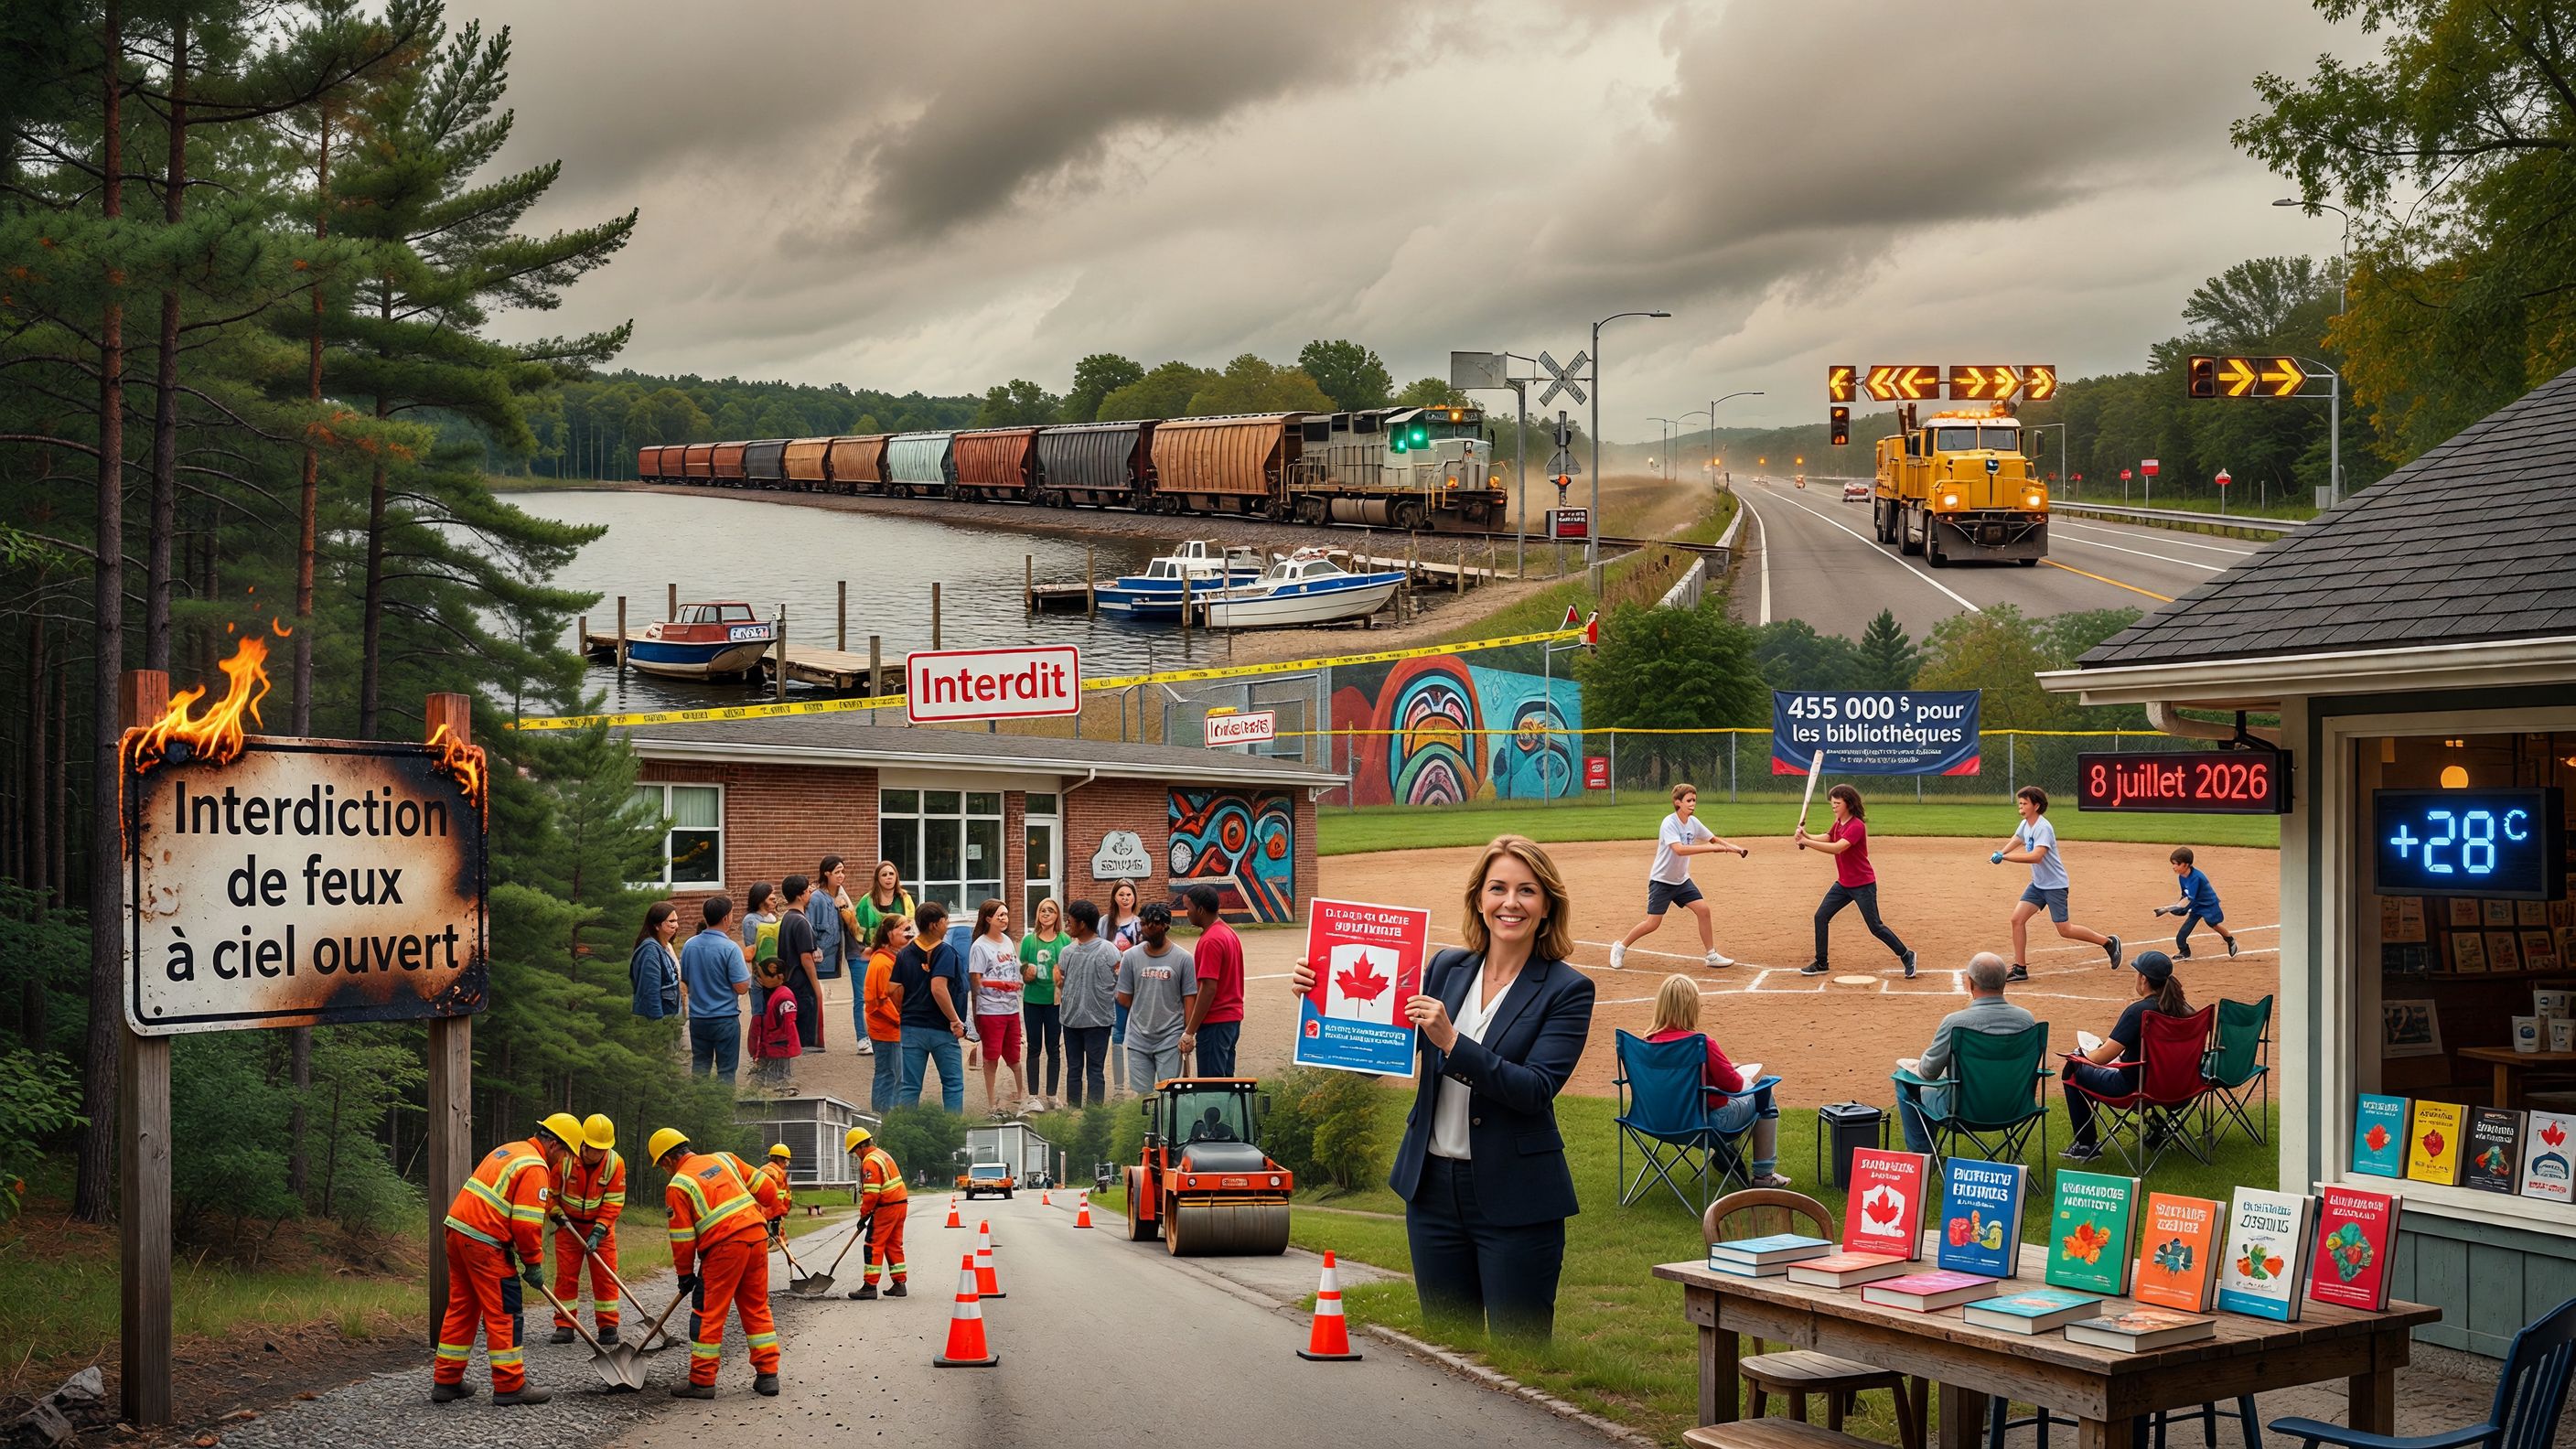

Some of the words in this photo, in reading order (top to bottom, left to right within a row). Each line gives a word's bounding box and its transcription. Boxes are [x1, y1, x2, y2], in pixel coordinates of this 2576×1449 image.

[922, 661, 1067, 704] Interdit
[1787, 696, 1838, 719] 455
[1844, 696, 1894, 719] 000
[1916, 704, 1965, 723] pour
[1793, 724, 1820, 742] les
[1827, 723, 1961, 746] bibliothèques
[2090, 764, 2107, 798] 8
[2112, 763, 2186, 806] juillet
[2195, 763, 2268, 800] 2026
[175, 780, 448, 837] Interdiction
[227, 853, 287, 907] de
[302, 853, 403, 906] feux
[166, 926, 195, 982] à
[212, 924, 295, 980] ciel
[313, 924, 459, 976] ouvert
